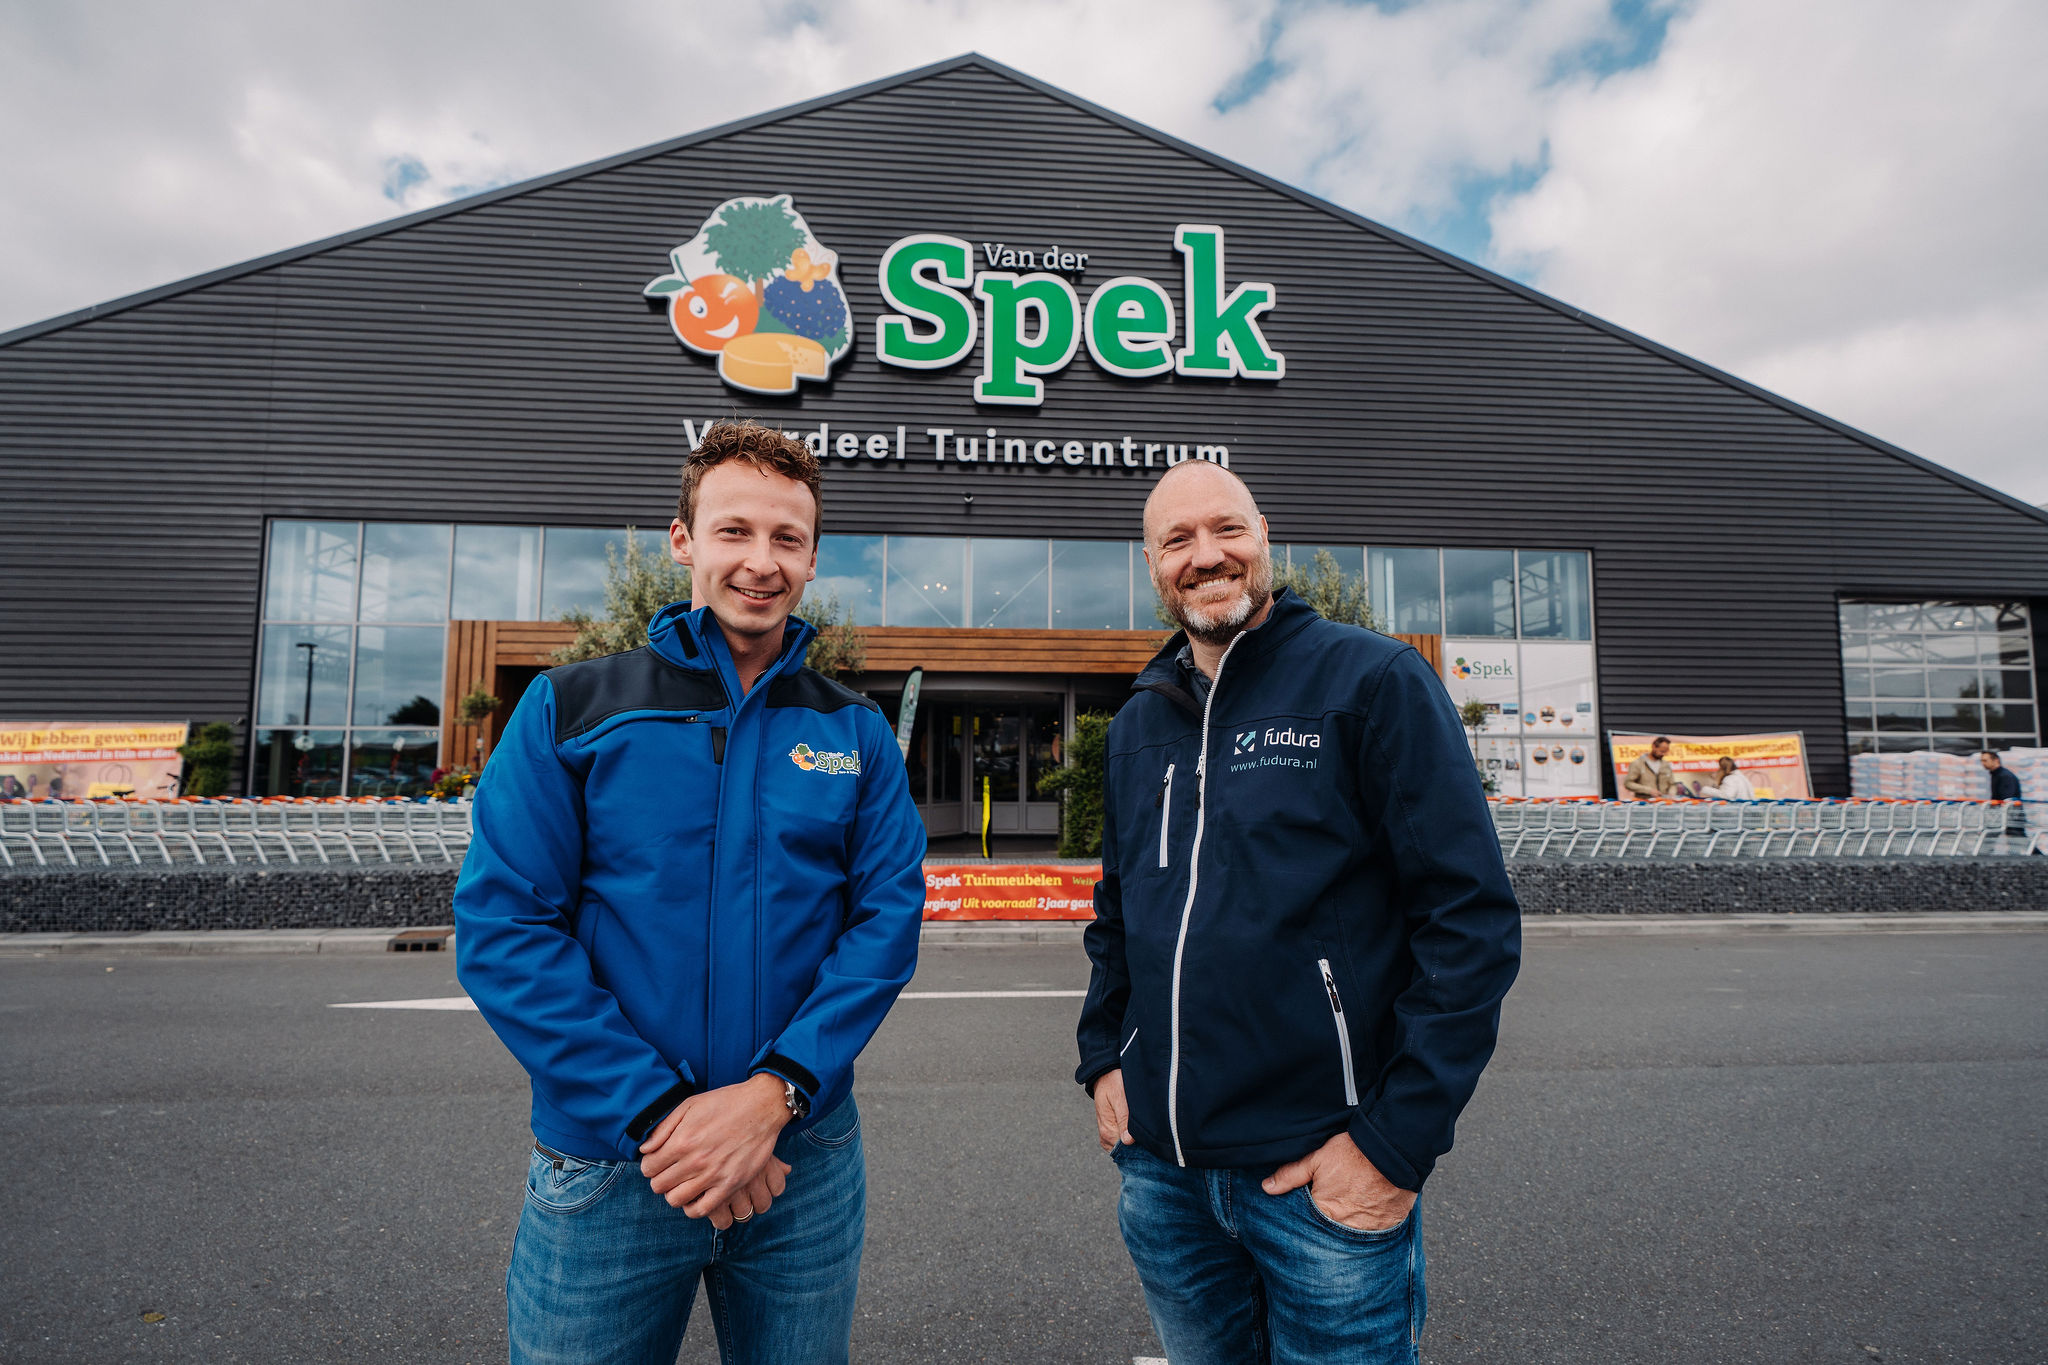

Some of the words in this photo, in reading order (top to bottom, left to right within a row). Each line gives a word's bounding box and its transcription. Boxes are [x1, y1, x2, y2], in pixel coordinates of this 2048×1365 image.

[983, 242, 1036, 268] Van
[1042, 245, 1088, 271] der
[876, 223, 1286, 405] Spek
[683, 419, 906, 460] Vdeel
[927, 428, 1230, 469] Tuincentrum
[1472, 659, 1513, 679] Spek
[0, 733, 26, 748] Wij
[31, 731, 90, 745] hebben
[94, 730, 183, 746] gewonnen!
[1264, 728, 1320, 748] fudura
[816, 750, 861, 774] Spek
[1230, 755, 1317, 773] www.fudura.nl
[926, 873, 961, 890] Spek
[963, 873, 1062, 887] Tuinmeubelen
[1072, 876, 1095, 886] Welk
[963, 898, 980, 909] Uit
[981, 897, 1037, 909] voorraad!
[1037, 897, 1046, 909] 2
[1044, 897, 1069, 911] jaar
